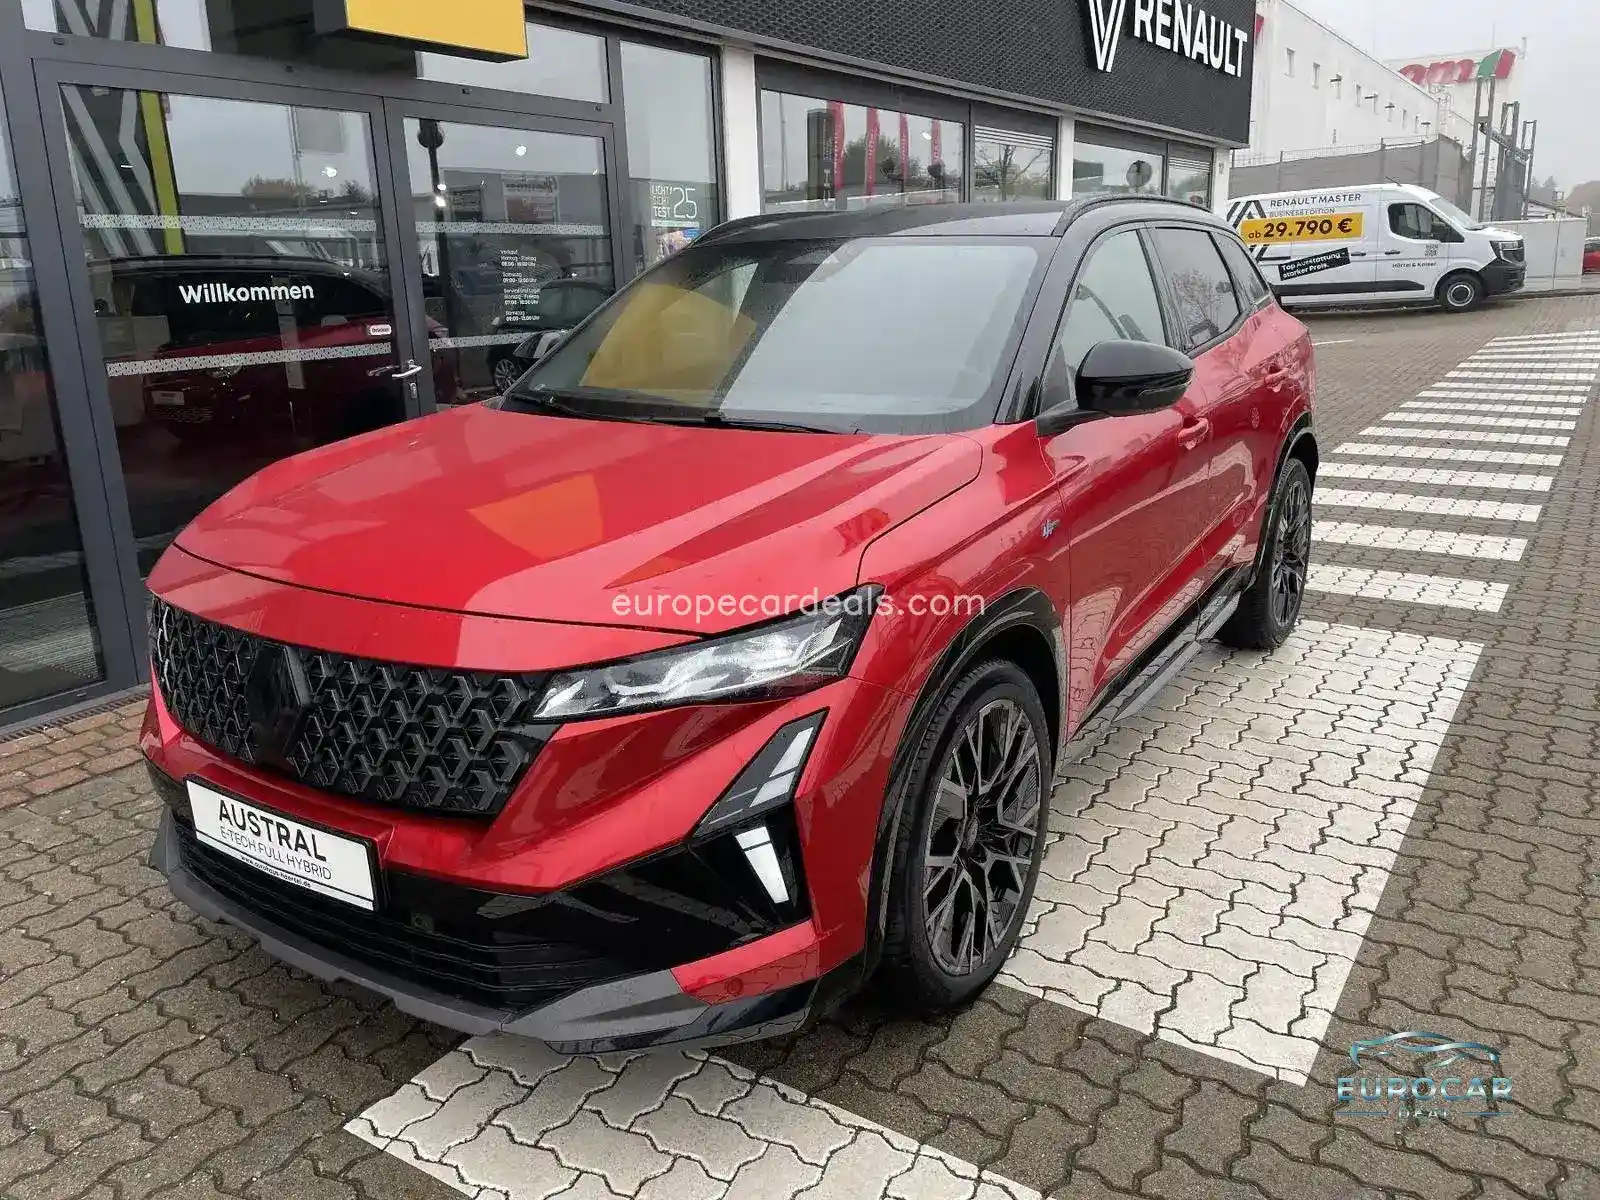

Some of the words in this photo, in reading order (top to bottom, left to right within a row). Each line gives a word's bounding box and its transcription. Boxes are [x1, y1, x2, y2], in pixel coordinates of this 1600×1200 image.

[1134, 0, 1248, 77] RENAULT
[673, 186, 698, 219] 25
[1270, 197, 1317, 207] RENAULT
[1318, 193, 1362, 204] MASTER
[653, 206, 671, 218] TEST
[1248, 230, 1261, 239] ab
[1263, 219, 1333, 238] 29.790
[1337, 217, 1353, 233] €
[1281, 263, 1296, 272] Top
[178, 283, 315, 304] Willkommen
[219, 799, 327, 862] AUSTRAL
[220, 826, 257, 852] E-TECH
[258, 842, 286, 864] FULL
[286, 854, 332, 880] HYBRID
